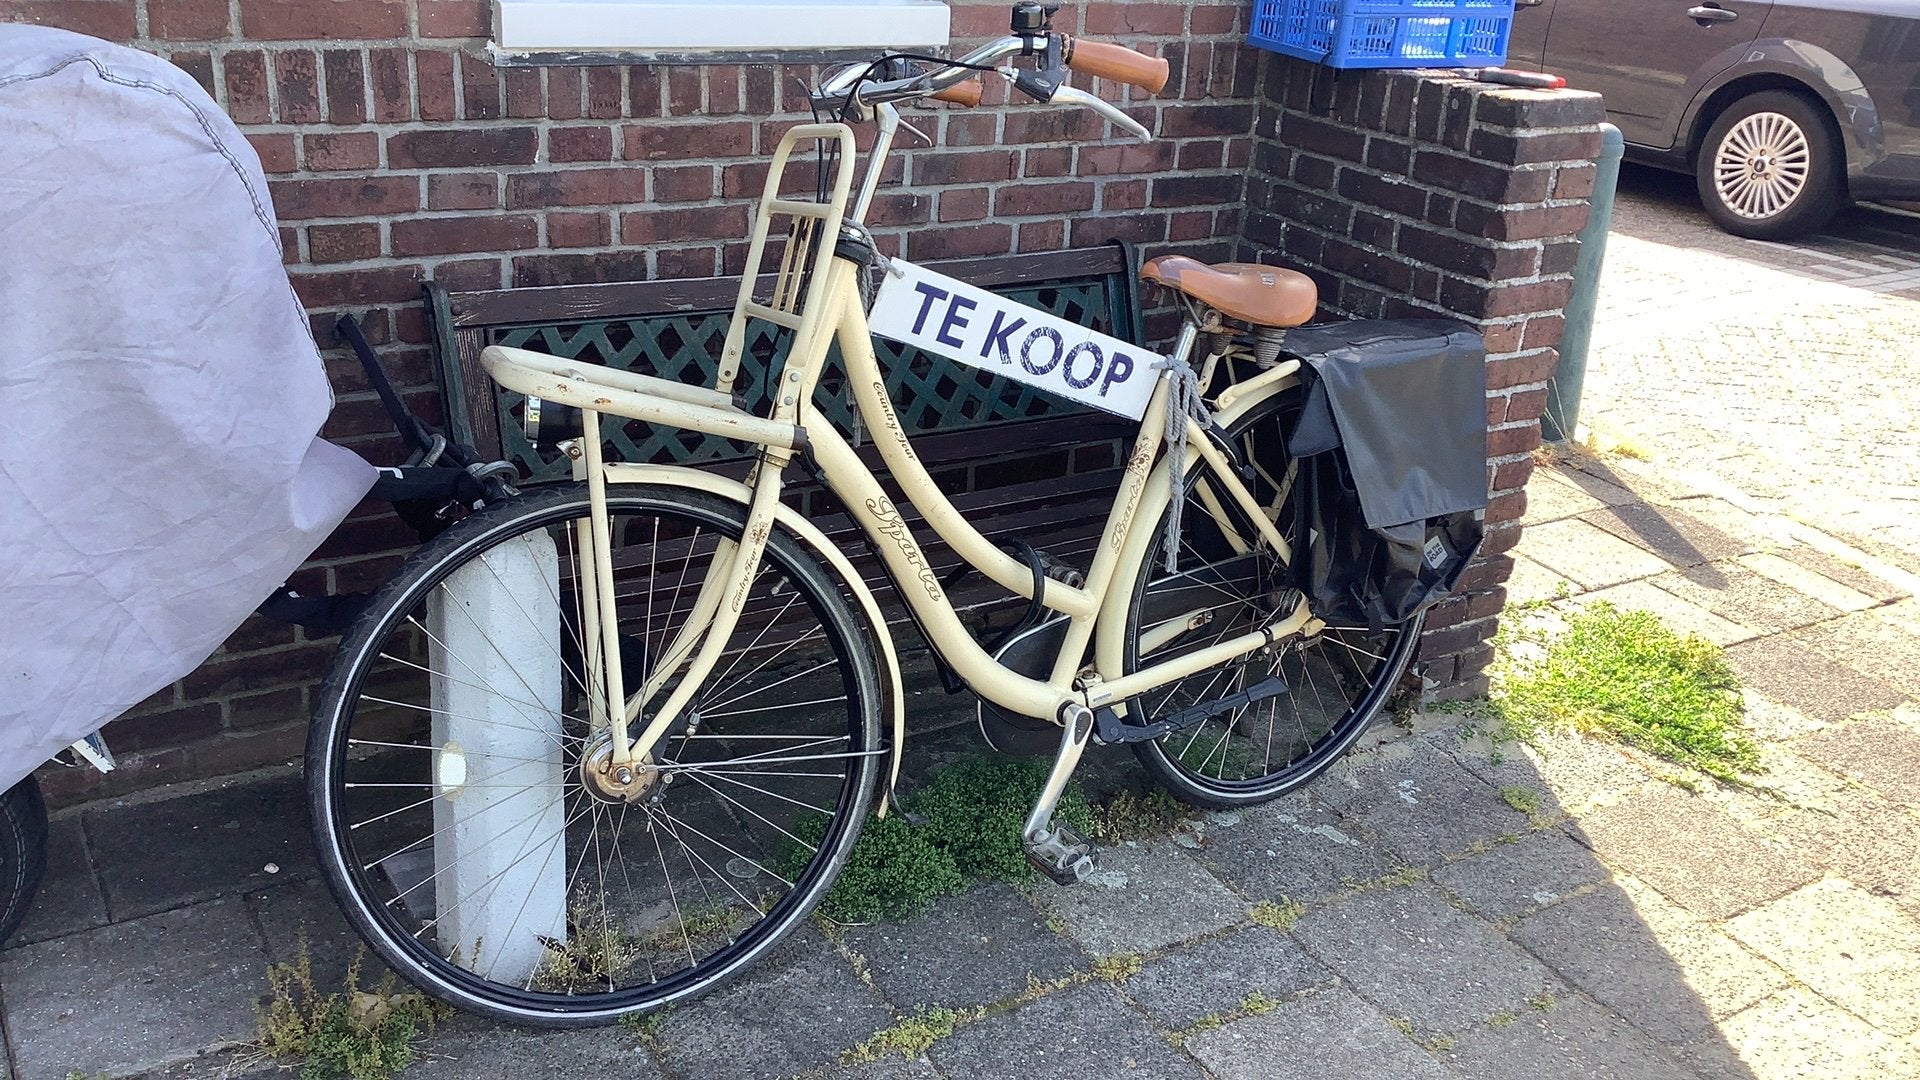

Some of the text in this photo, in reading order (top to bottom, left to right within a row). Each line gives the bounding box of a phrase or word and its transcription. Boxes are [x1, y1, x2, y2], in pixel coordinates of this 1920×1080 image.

[911, 281, 1134, 398] TE KOOP
[872, 381, 915, 461] Country Tour
[731, 575, 750, 613] Country
[865, 496, 941, 602] Sparta
